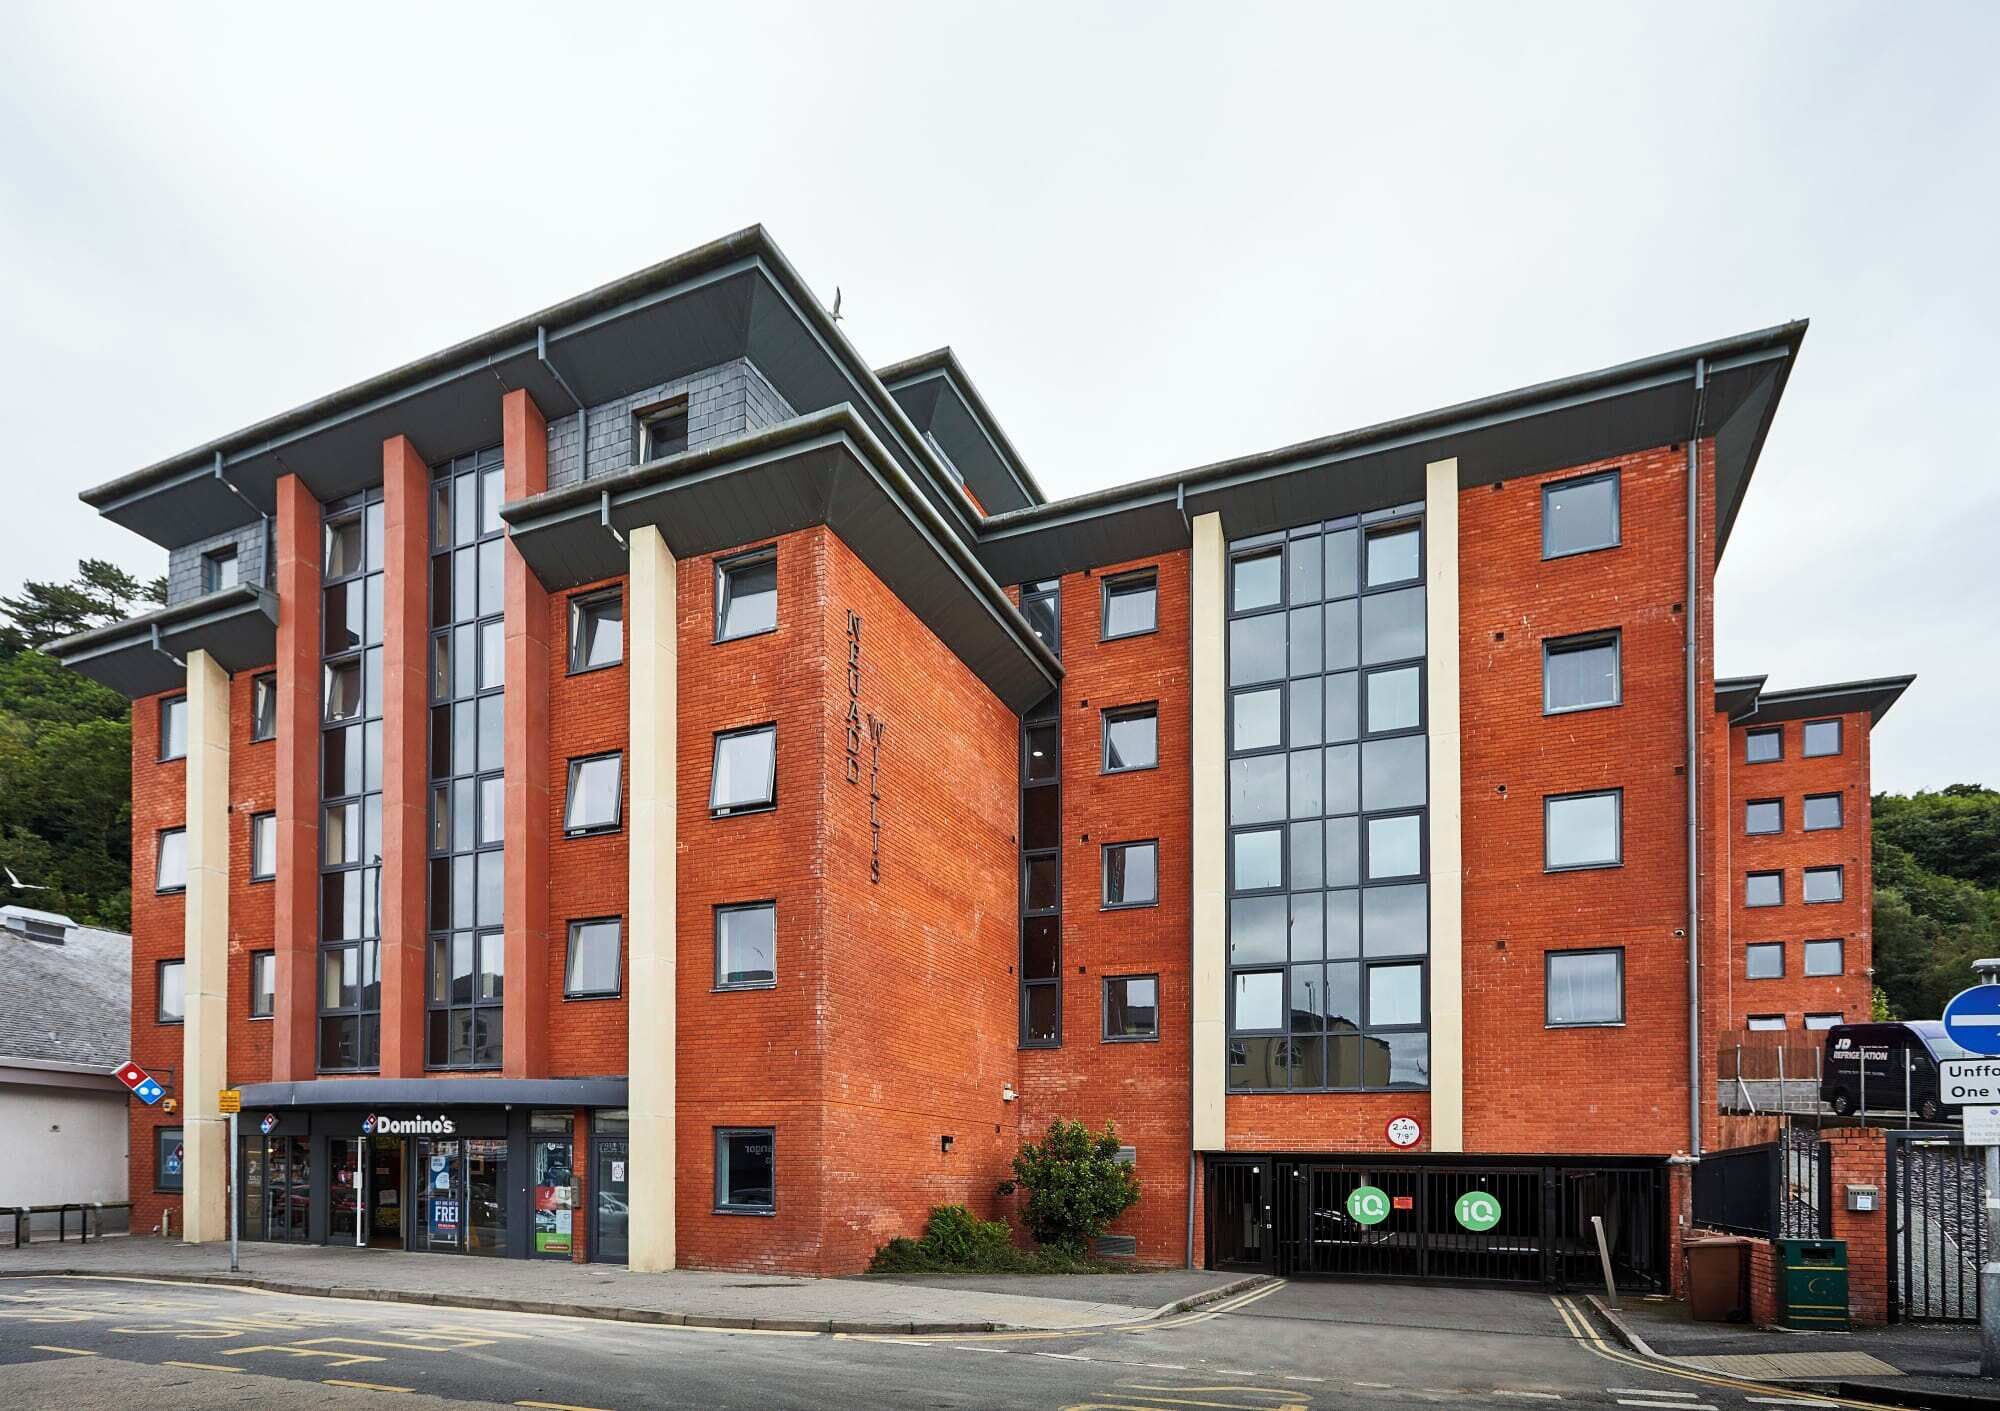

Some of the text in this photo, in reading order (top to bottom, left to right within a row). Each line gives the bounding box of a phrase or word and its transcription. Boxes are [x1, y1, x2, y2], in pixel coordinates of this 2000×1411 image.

[846, 608, 863, 785] NEUADD
[867, 712, 886, 885] WILLIS
[1835, 1038, 1851, 1050] JD
[1951, 1086, 1990, 1098] One
[377, 1114, 454, 1134] Domino's
